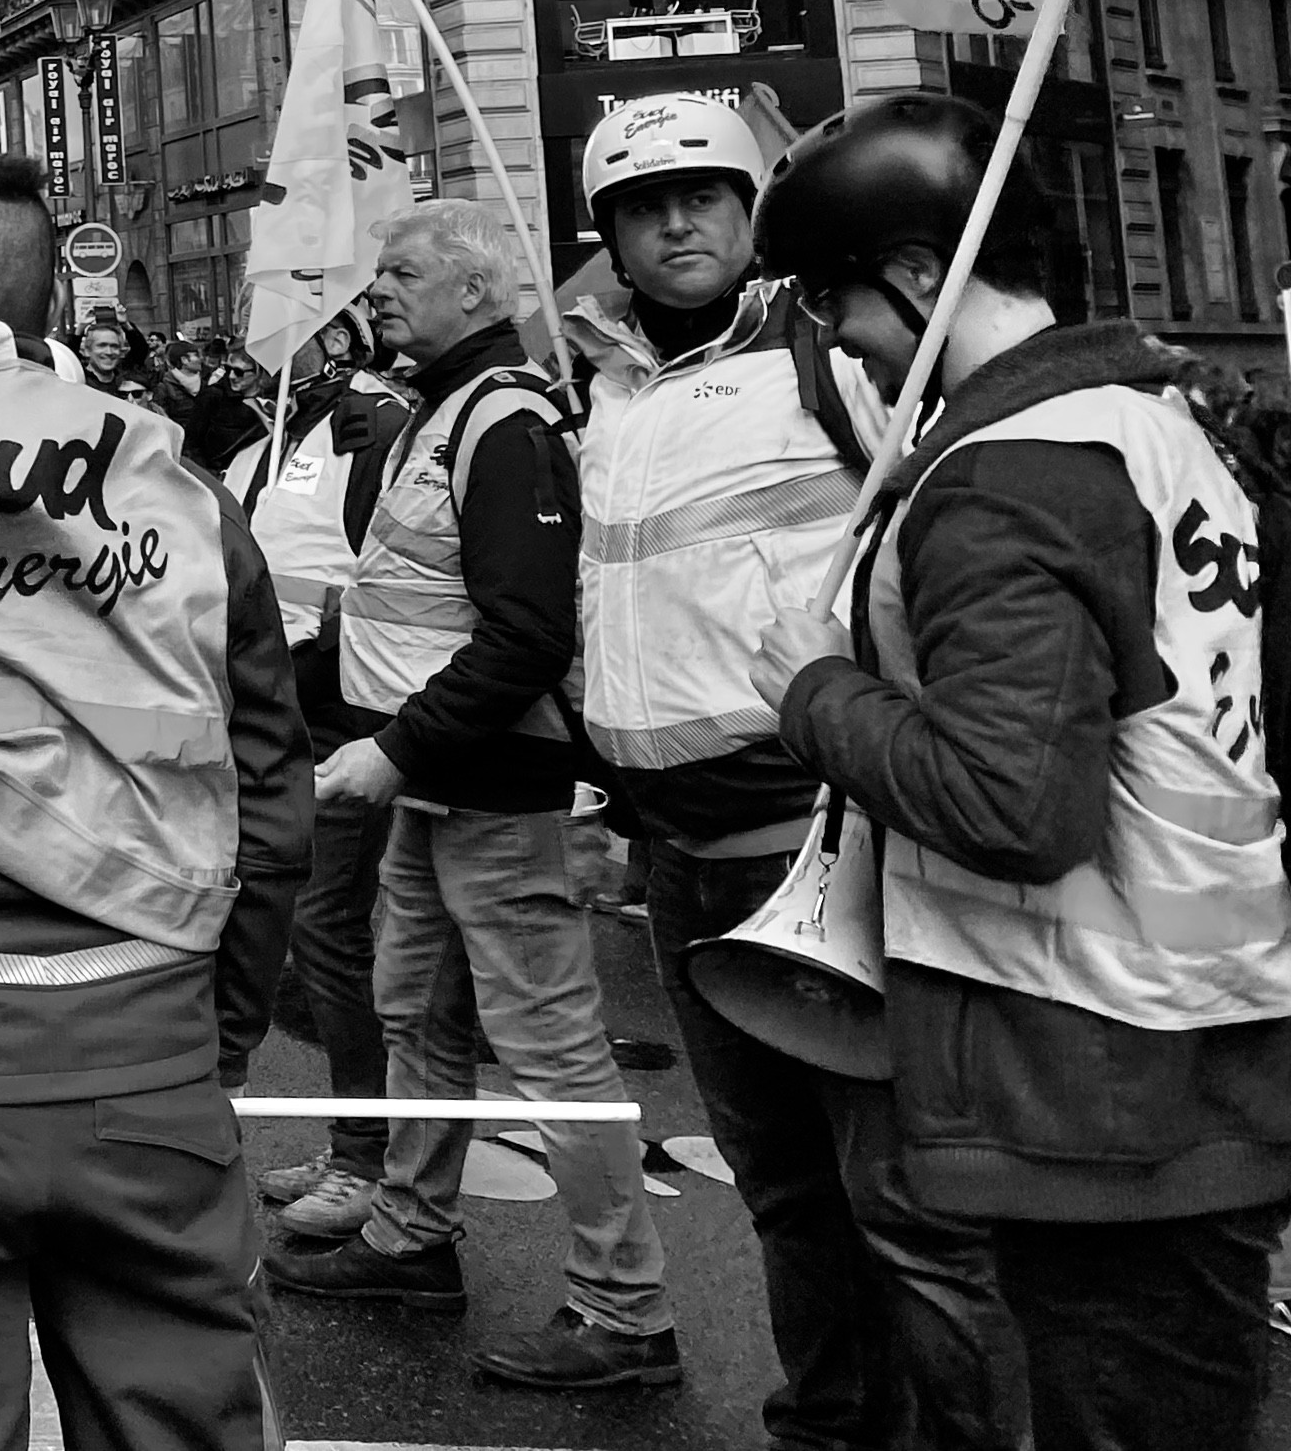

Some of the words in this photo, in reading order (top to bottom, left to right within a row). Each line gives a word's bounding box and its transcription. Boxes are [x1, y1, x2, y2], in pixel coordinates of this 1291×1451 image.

[47, 63, 60, 109] royal
[100, 40, 113, 90] royal
[50, 117, 61, 143] air
[102, 98, 115, 126] air
[49, 151, 65, 193] maroc
[102, 135, 119, 179] maroc
